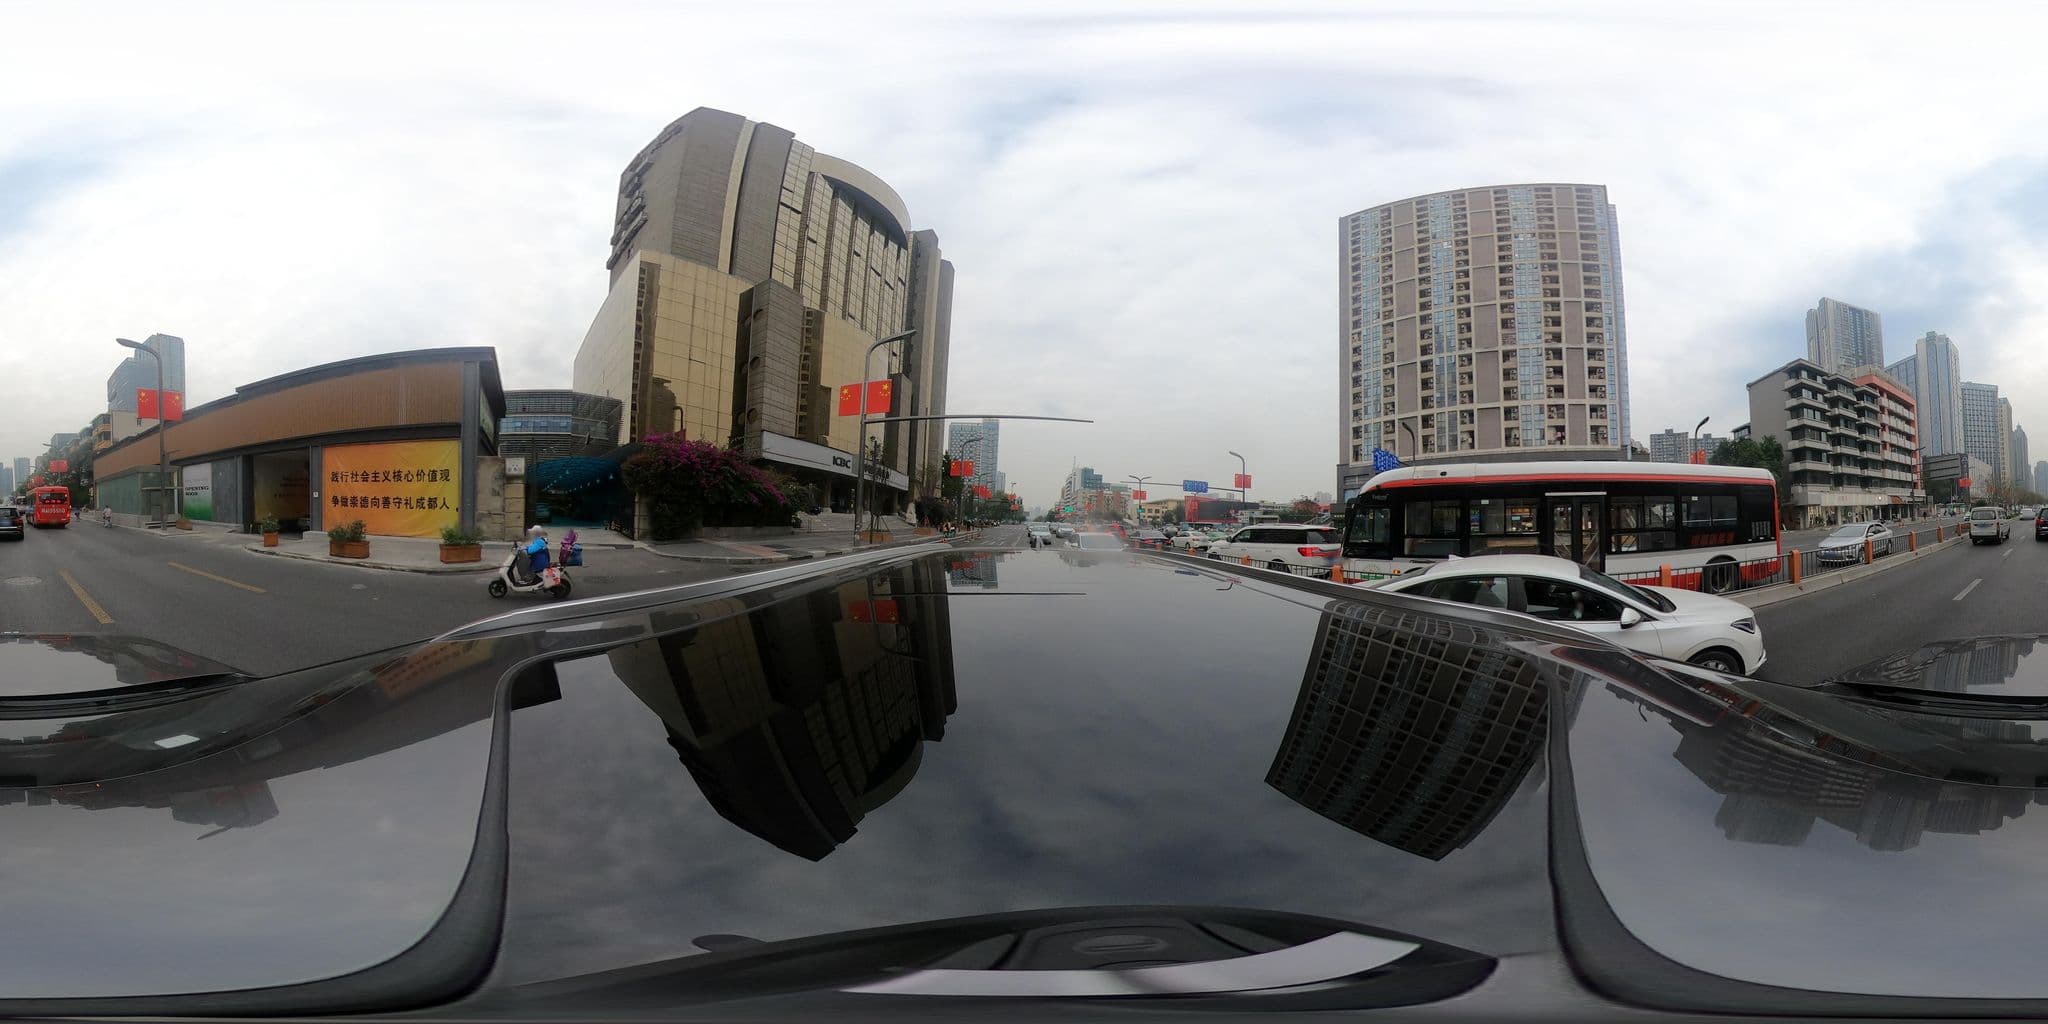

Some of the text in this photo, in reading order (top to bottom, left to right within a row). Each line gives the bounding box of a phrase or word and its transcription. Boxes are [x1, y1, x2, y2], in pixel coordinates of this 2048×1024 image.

[832, 455, 851, 469] ICBC
[330, 468, 450, 483] 践行社会主义核心价值观
[331, 495, 450, 510] 争做崇德向善守礼成都人
